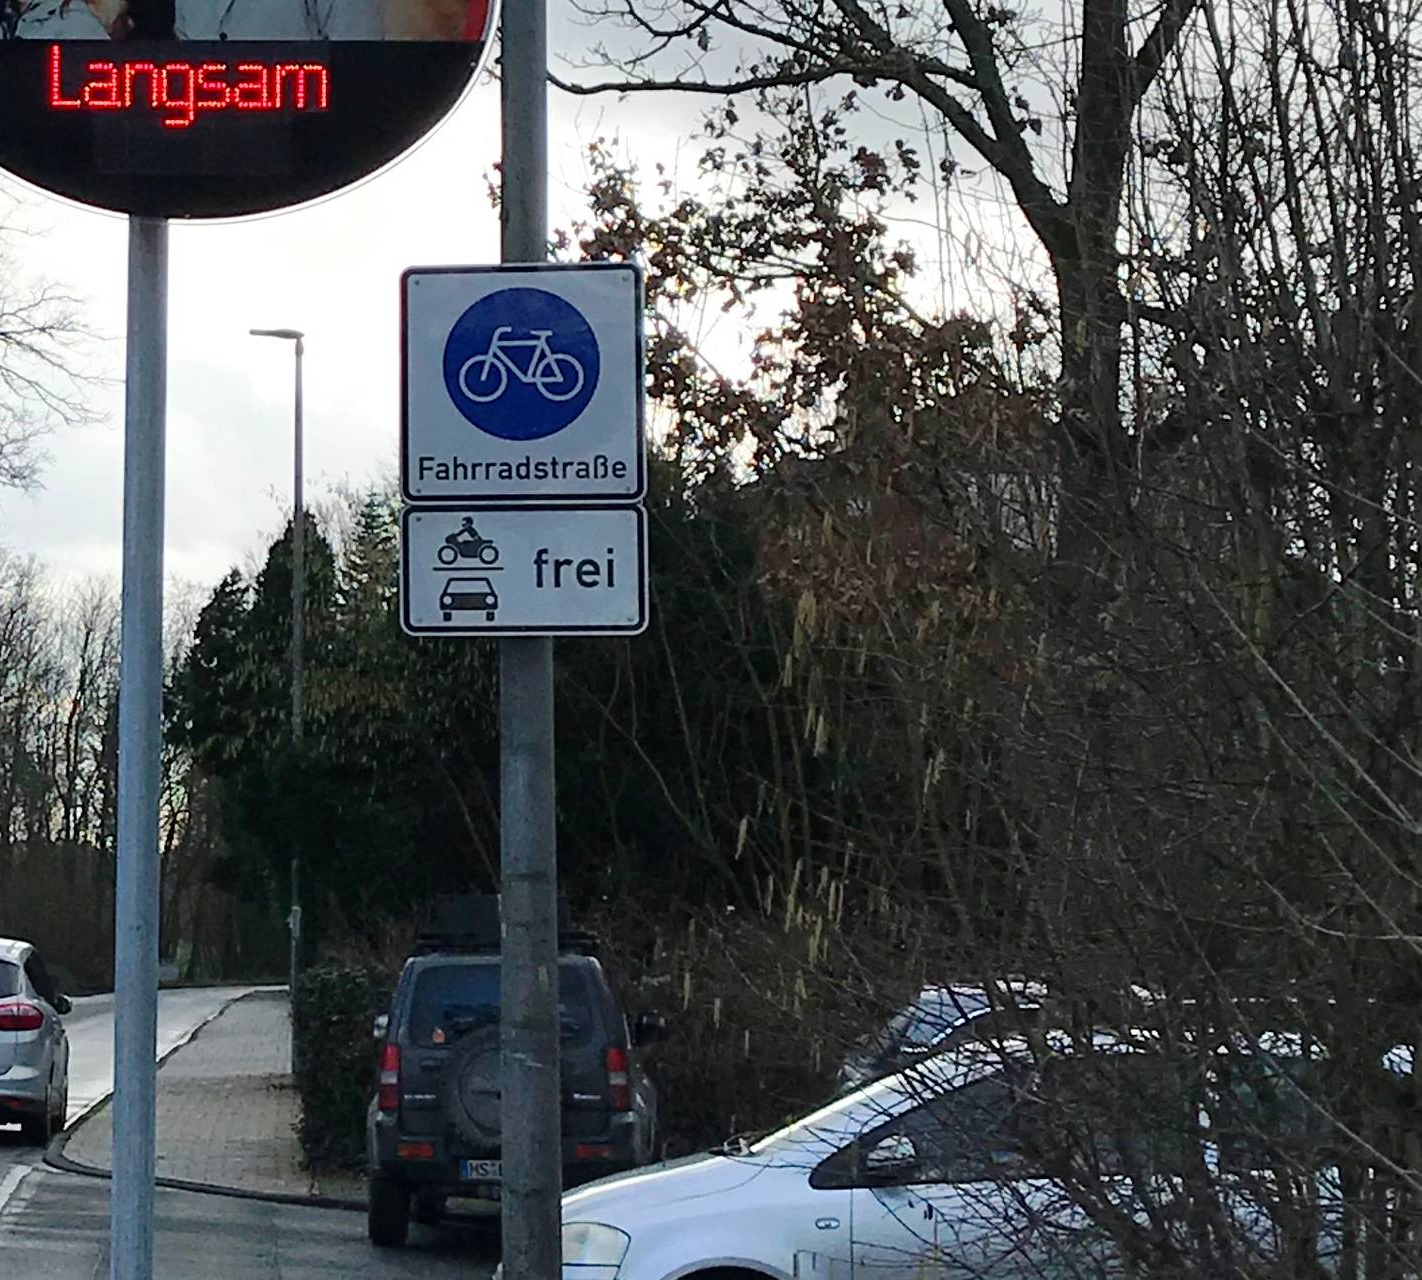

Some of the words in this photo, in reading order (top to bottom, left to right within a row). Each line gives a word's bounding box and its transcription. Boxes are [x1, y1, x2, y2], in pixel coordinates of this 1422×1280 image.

[49, 44, 329, 127] Langsam
[418, 454, 628, 481] Fahrradstraße
[533, 547, 615, 588] frei
[469, 1162, 489, 1177] MS
